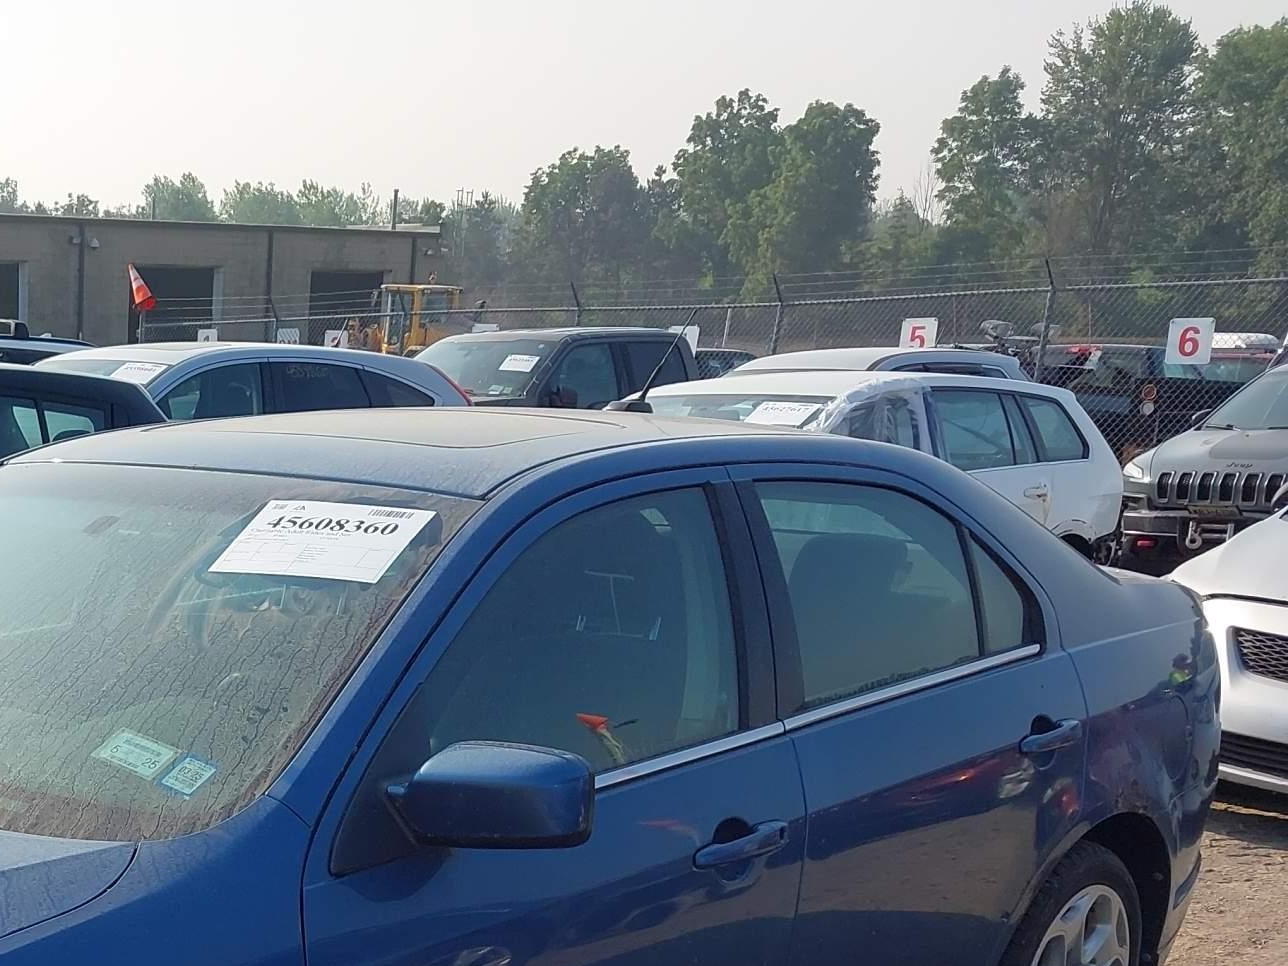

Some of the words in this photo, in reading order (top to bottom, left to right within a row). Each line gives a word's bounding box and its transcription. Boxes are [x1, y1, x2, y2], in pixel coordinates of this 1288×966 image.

[910, 326, 926, 348] 5
[1178, 326, 1201, 357] 6
[267, 515, 399, 536] 45608360
